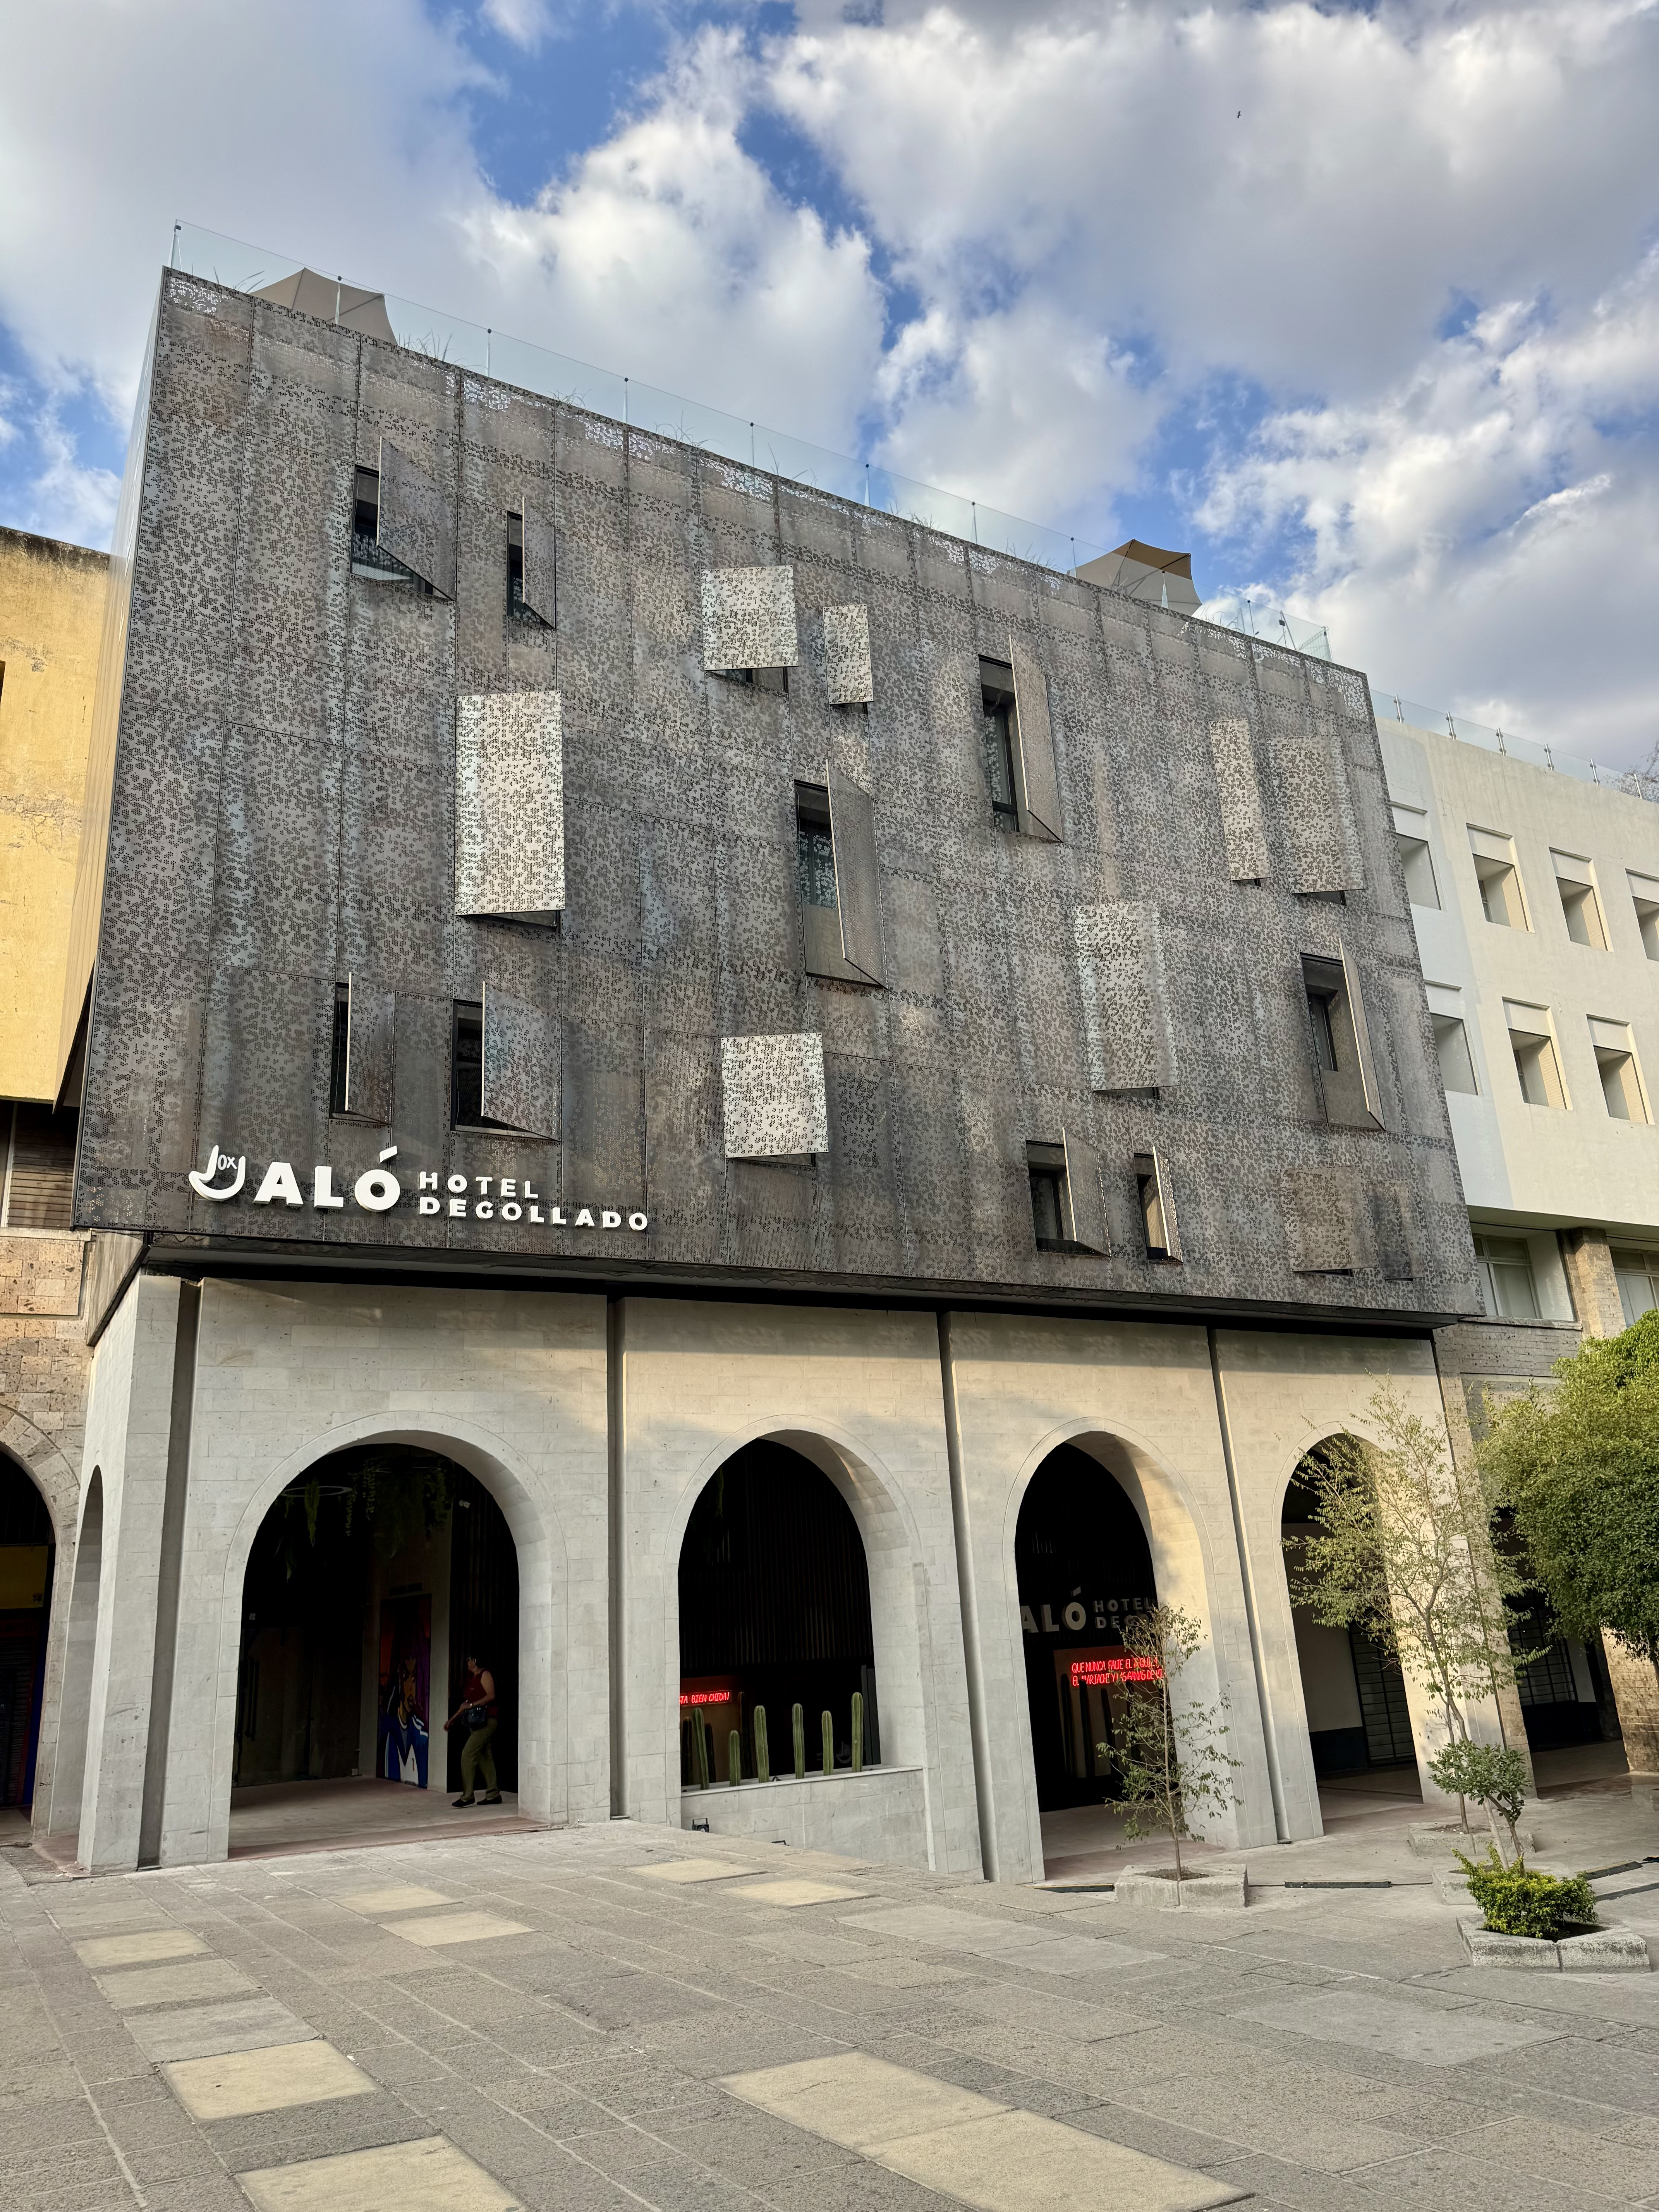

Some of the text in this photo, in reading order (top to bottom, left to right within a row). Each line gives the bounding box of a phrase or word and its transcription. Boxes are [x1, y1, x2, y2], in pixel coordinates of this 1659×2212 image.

[253, 1145, 400, 1212] ALÓ
[419, 1171, 538, 1200] HOTEL
[419, 1197, 648, 1231] DEGOLLADO
[1020, 1587, 1086, 1633] ALÓ
[1093, 1597, 1153, 1613] HOTEL
[1072, 1662, 1084, 1673] QUE
[1085, 1661, 1106, 1672] NUNCA
[1108, 1659, 1123, 1670] FALTE
[1125, 1659, 1132, 1669] EL
[1073, 1675, 1079, 1686] EL
[1147, 1669, 1154, 1680] DE
[691, 1694, 707, 1704] BIEN
